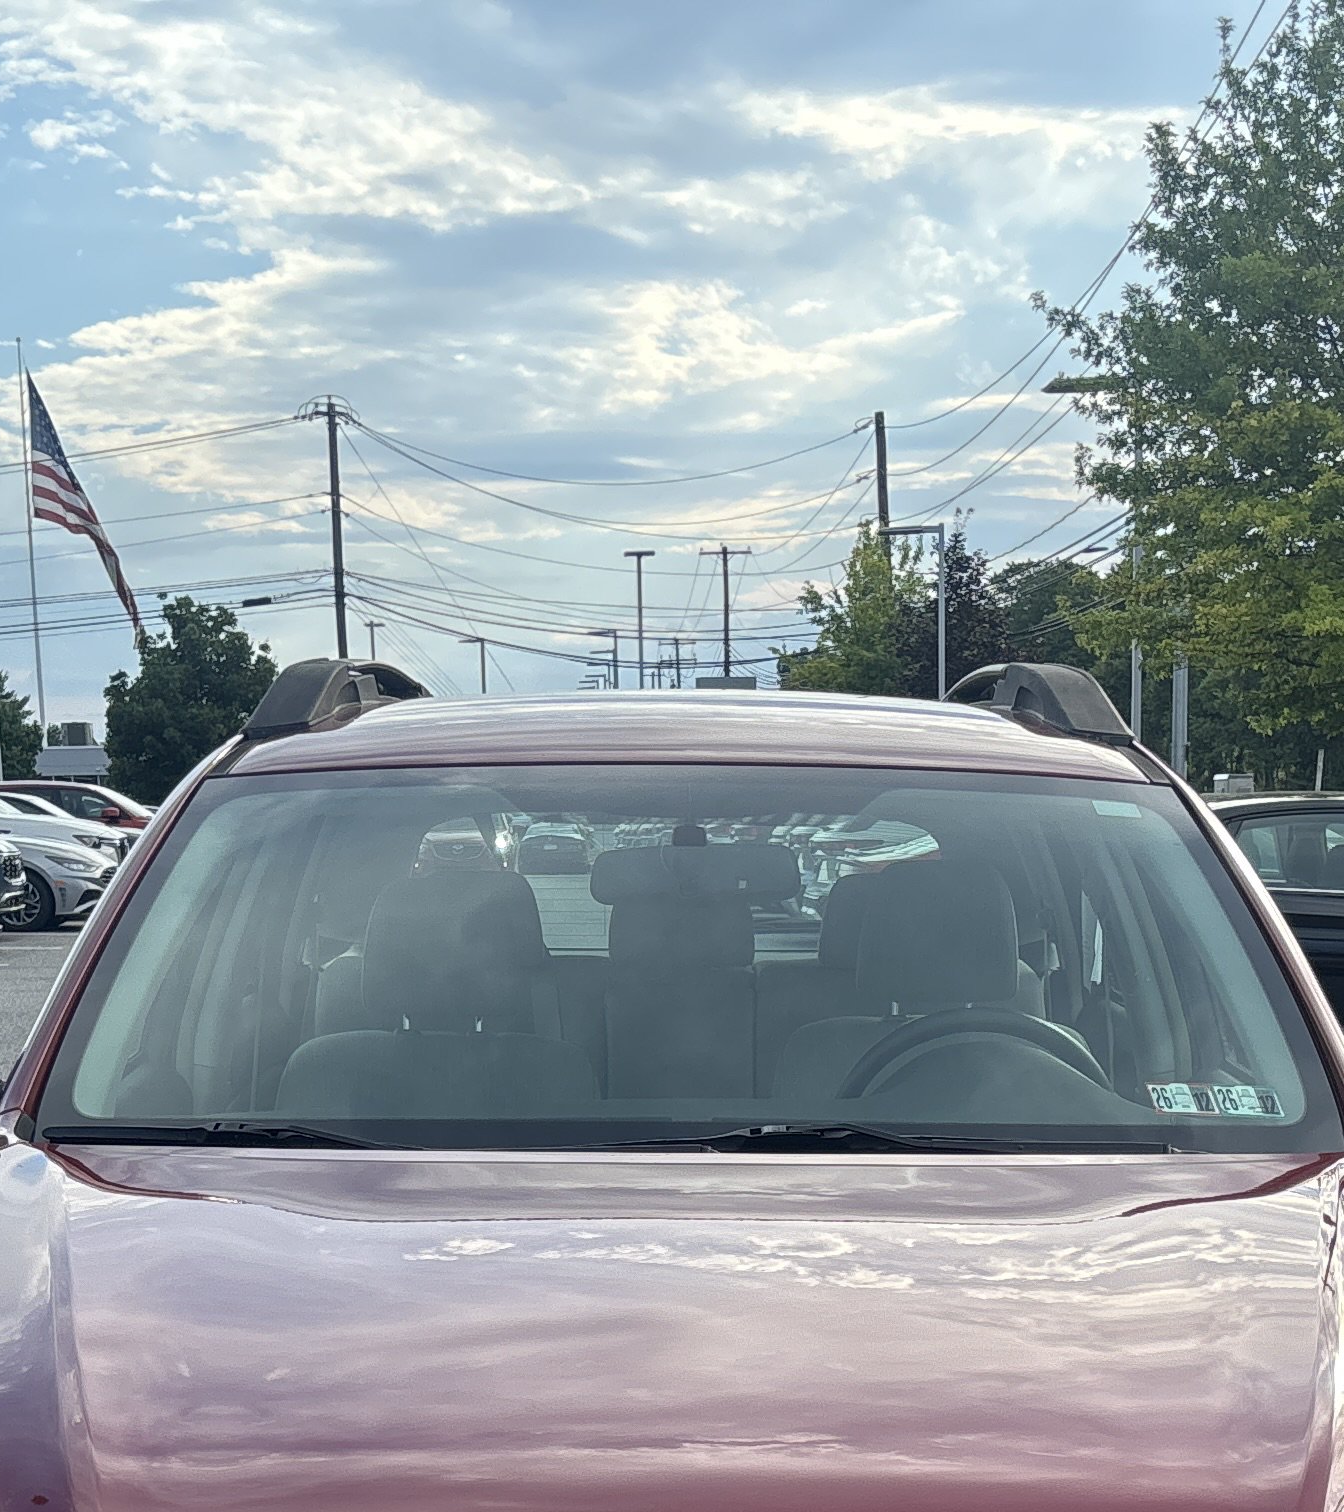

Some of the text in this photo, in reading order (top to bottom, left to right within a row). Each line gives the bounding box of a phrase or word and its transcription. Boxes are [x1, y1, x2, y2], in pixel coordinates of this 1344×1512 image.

[1152, 1087, 1216, 1112] 26 12
[1217, 1088, 1239, 1111] 26
